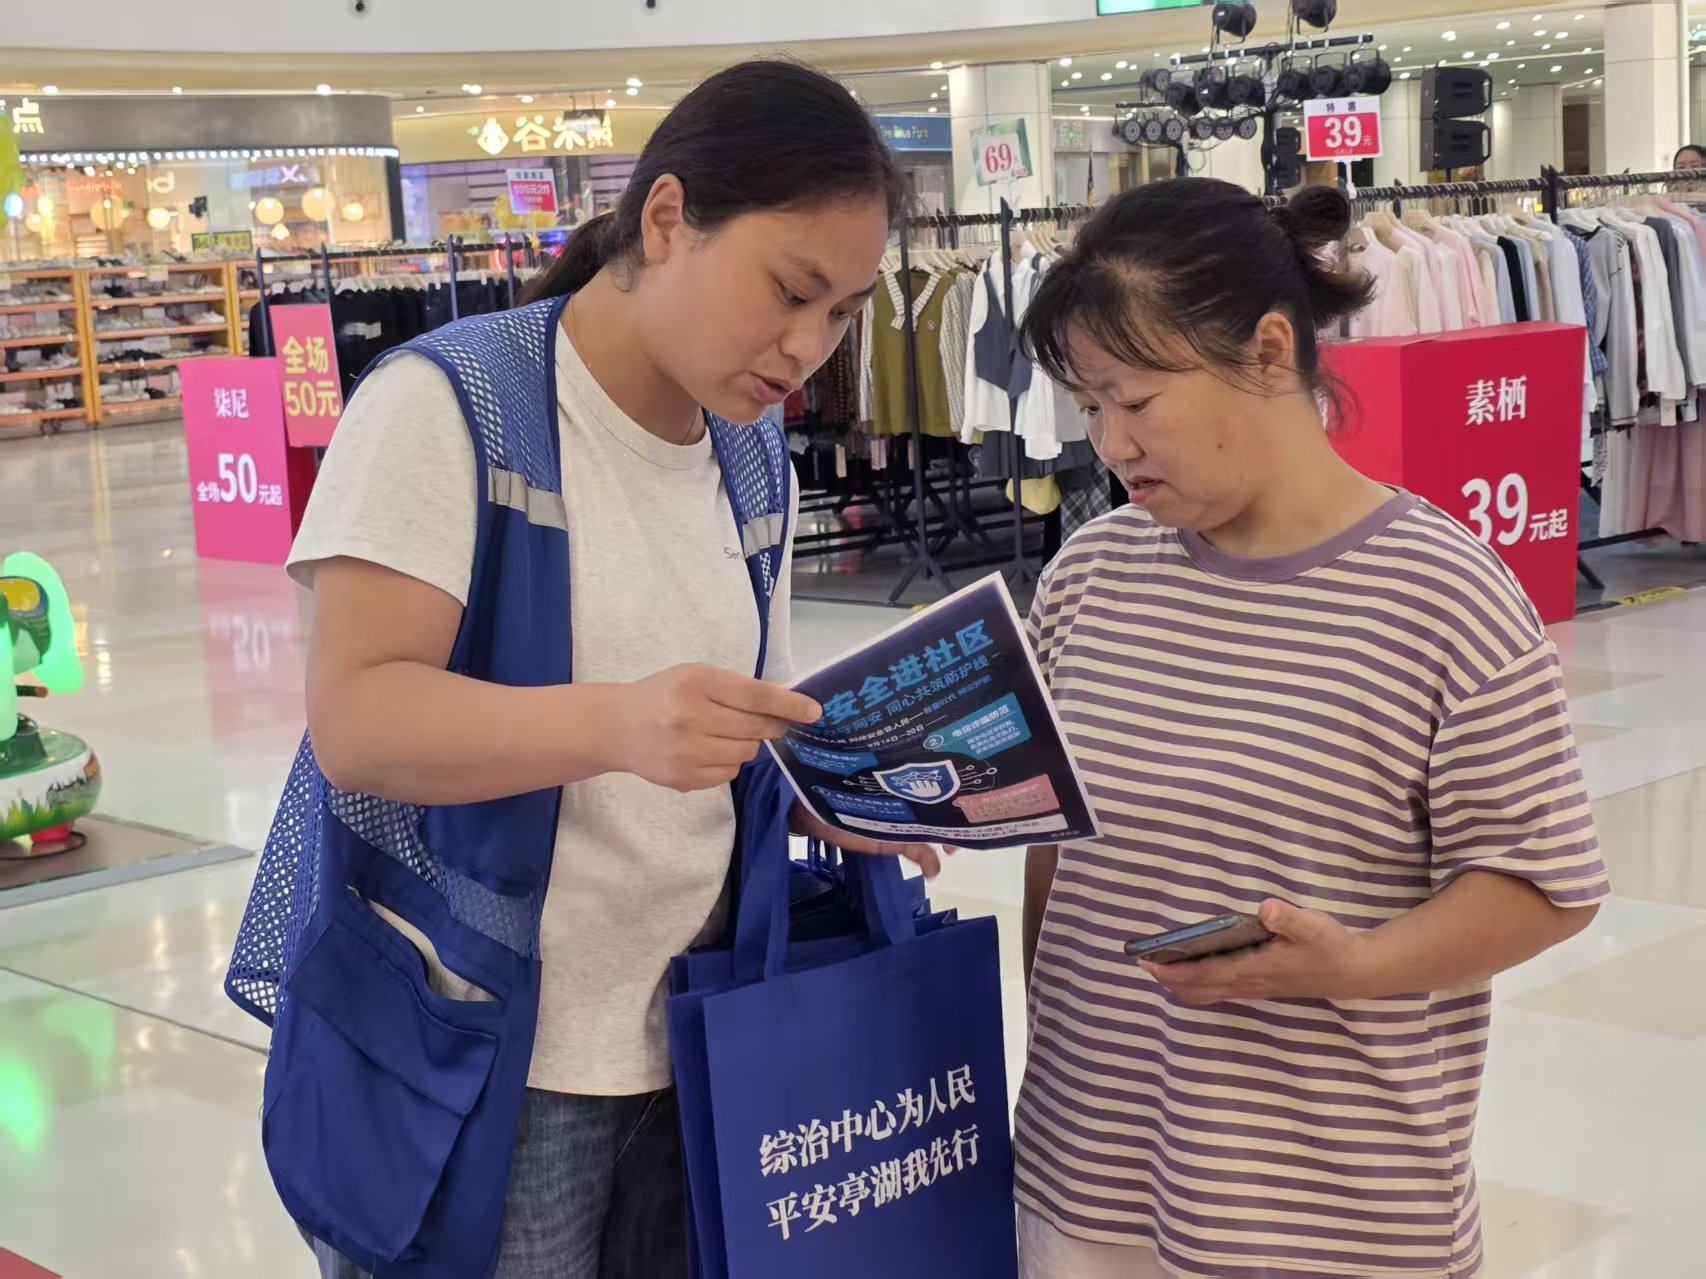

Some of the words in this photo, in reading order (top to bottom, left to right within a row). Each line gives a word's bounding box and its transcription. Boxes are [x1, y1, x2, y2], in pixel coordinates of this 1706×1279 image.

[984, 143, 1013, 174] 69
[282, 336, 329, 374] 全场
[284, 380, 341, 417] 50元
[1465, 375, 1527, 426] 素栖
[1461, 472, 1568, 546] 39元起
[813, 618, 995, 730] 安全进社区
[759, 1064, 976, 1177] 综治中心为人民
[766, 1123, 980, 1240] 平安亭湖我先行
